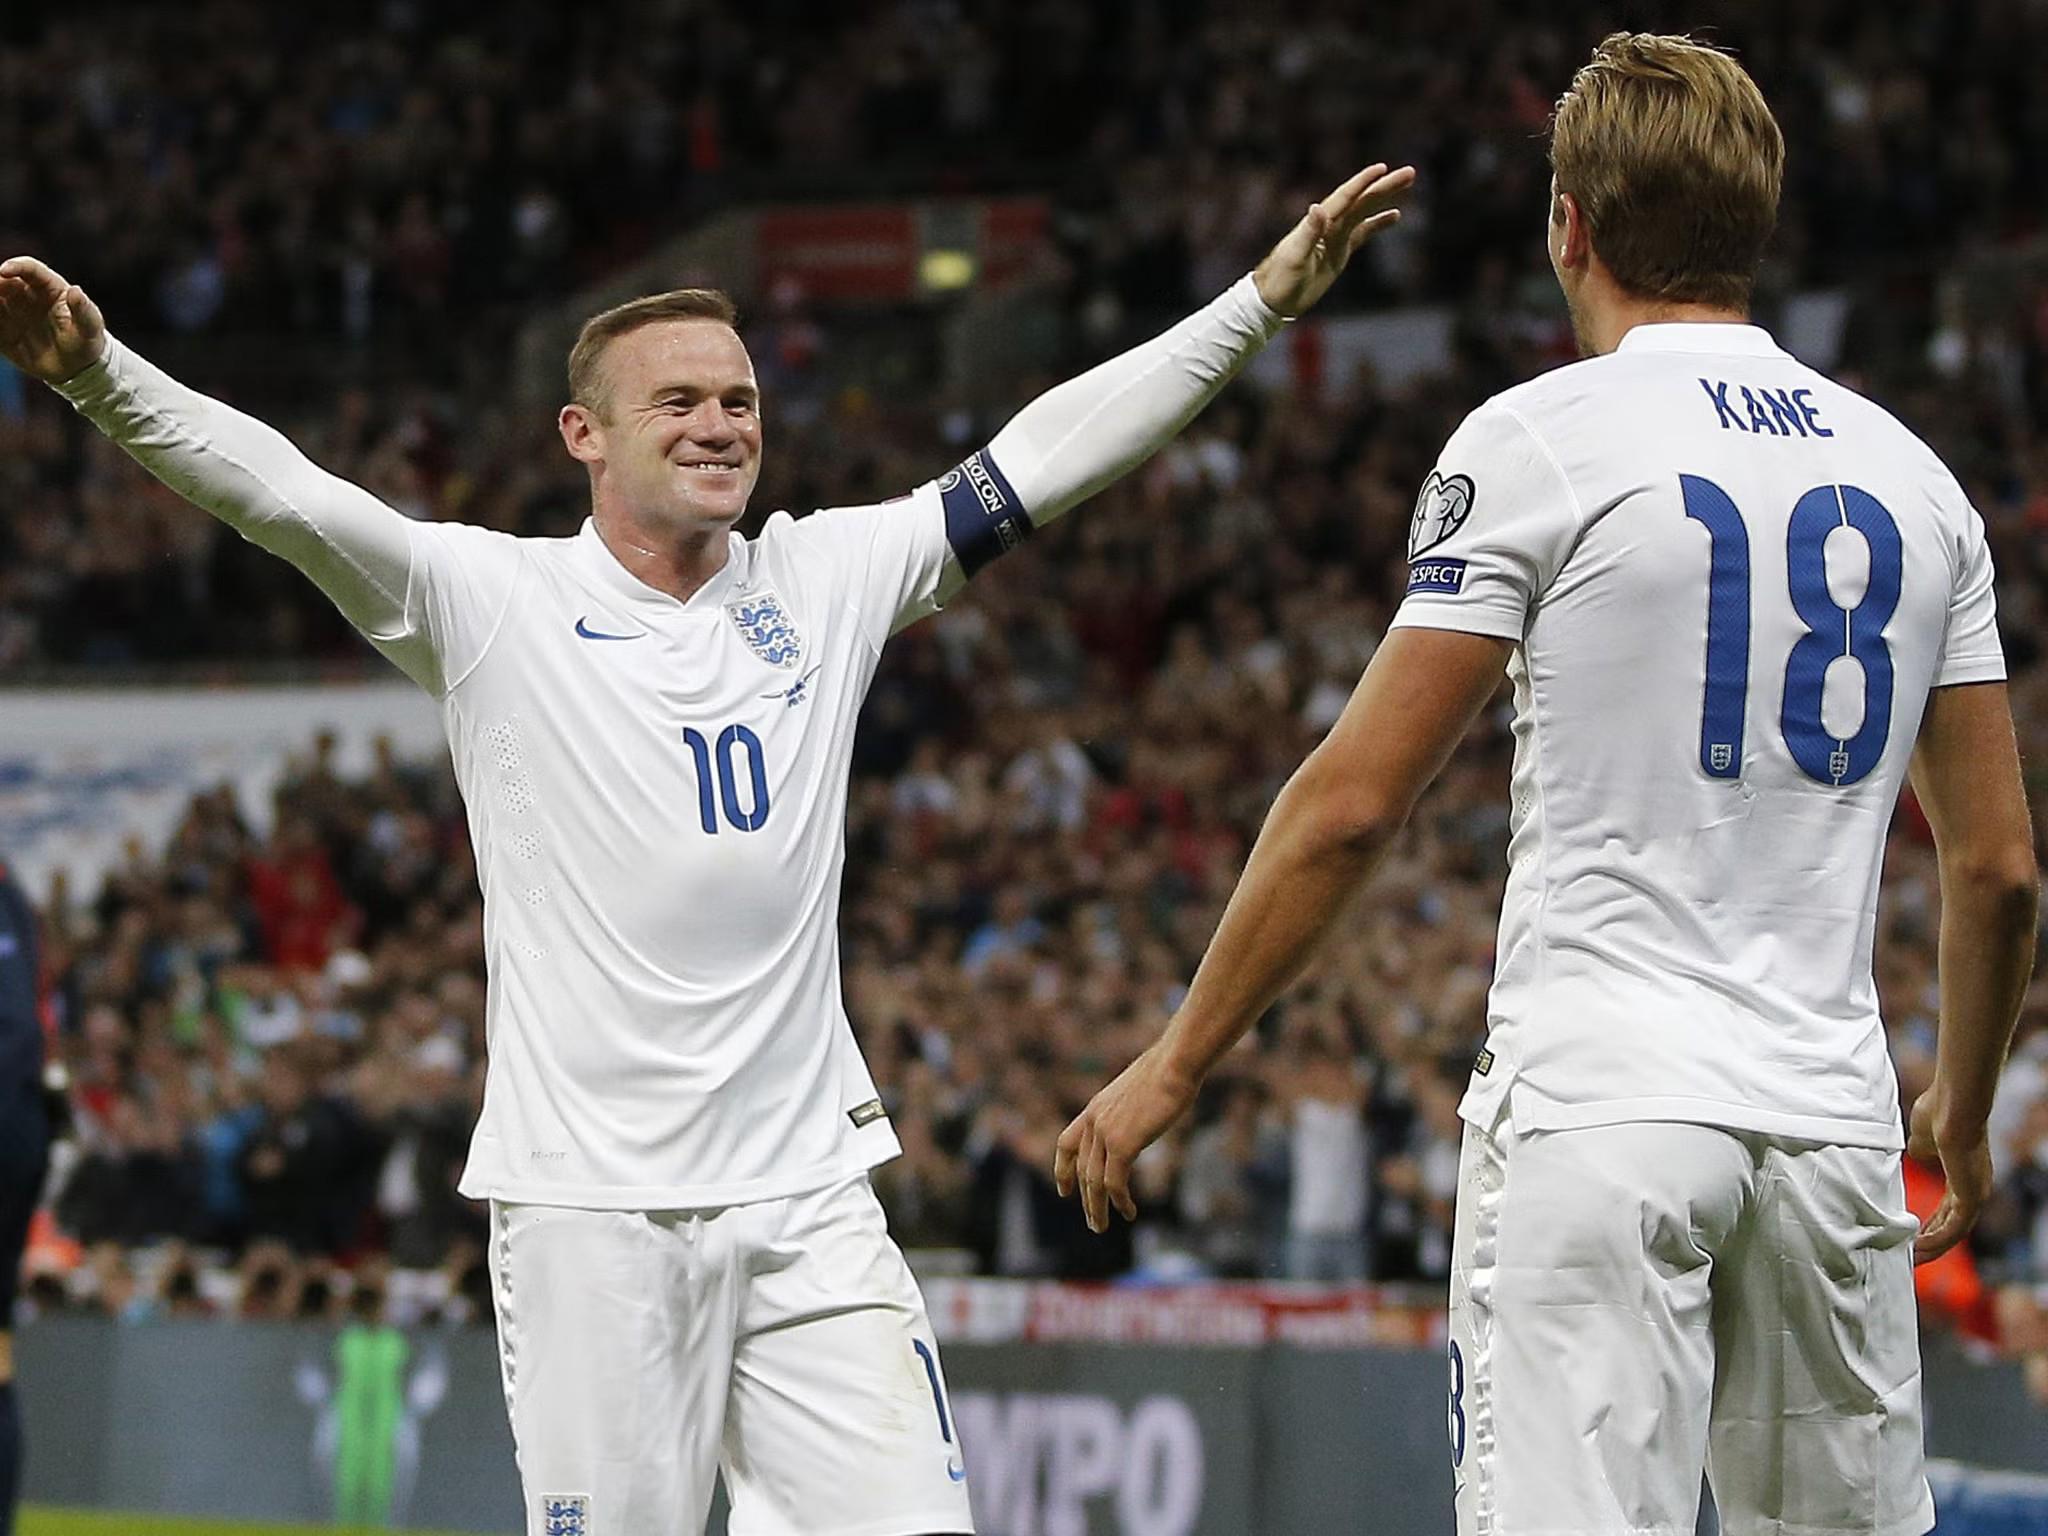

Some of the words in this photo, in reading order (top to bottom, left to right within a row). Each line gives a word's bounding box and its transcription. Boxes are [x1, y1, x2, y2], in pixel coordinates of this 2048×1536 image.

[1698, 377, 1833, 438] KANE
[1679, 473, 1903, 787] 18
[682, 723, 771, 835] 10
